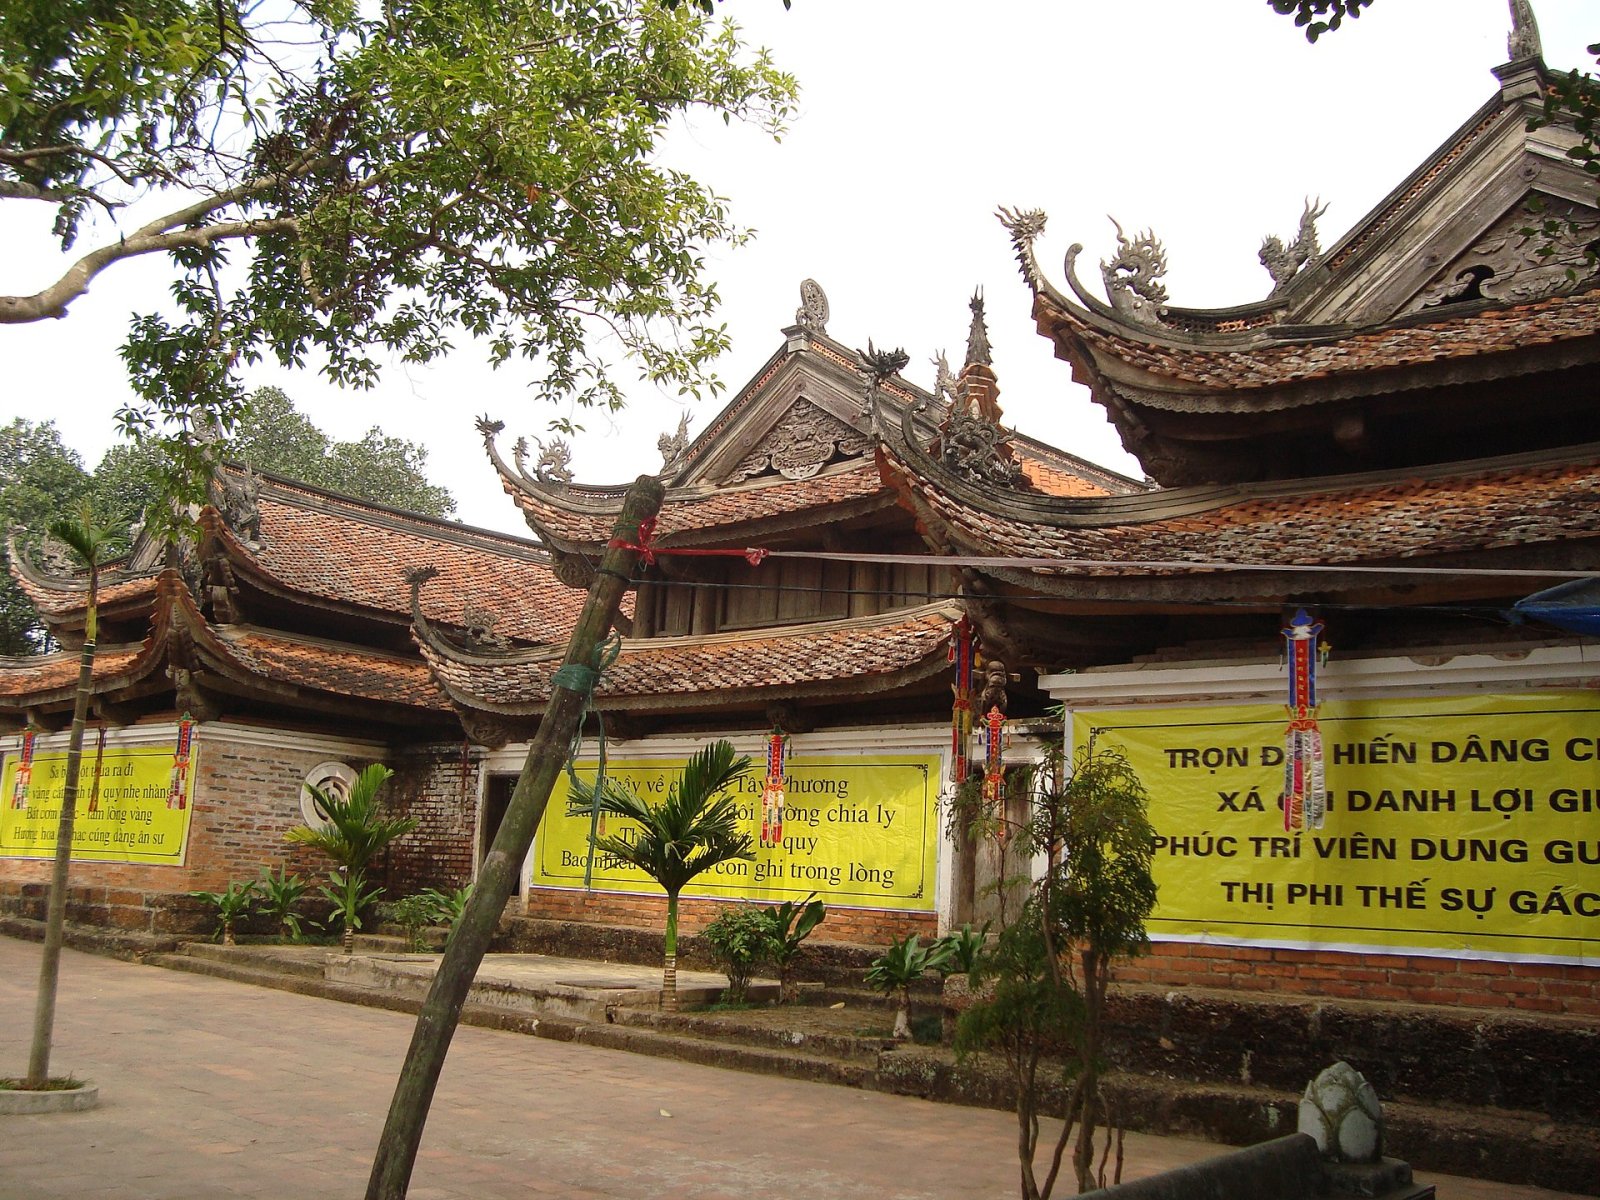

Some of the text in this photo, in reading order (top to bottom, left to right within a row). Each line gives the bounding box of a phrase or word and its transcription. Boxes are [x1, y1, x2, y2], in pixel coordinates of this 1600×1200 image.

[1164, 746, 1248, 774] TRỌN
[1333, 733, 1416, 764] HIẾN
[1431, 734, 1550, 763] DÂNG
[647, 774, 665, 793] về
[827, 804, 869, 824] chia
[877, 804, 896, 829] ly
[1217, 786, 1265, 812] XÁ
[1347, 790, 1456, 812] DANH
[1471, 788, 1533, 820] LỢI
[783, 836, 818, 855] quy
[1151, 831, 1238, 857] PHÚC
[1249, 832, 1303, 858] TRÍ
[1313, 832, 1396, 860] VIÊN
[1411, 838, 1528, 862] DUNG
[561, 850, 588, 867] Bao
[715, 861, 747, 876] con
[754, 859, 784, 881] ghi
[791, 862, 842, 886] trong
[849, 862, 894, 888] lòng
[1221, 878, 1600, 919] THỊ PHI THẾ SỰ GÁC
